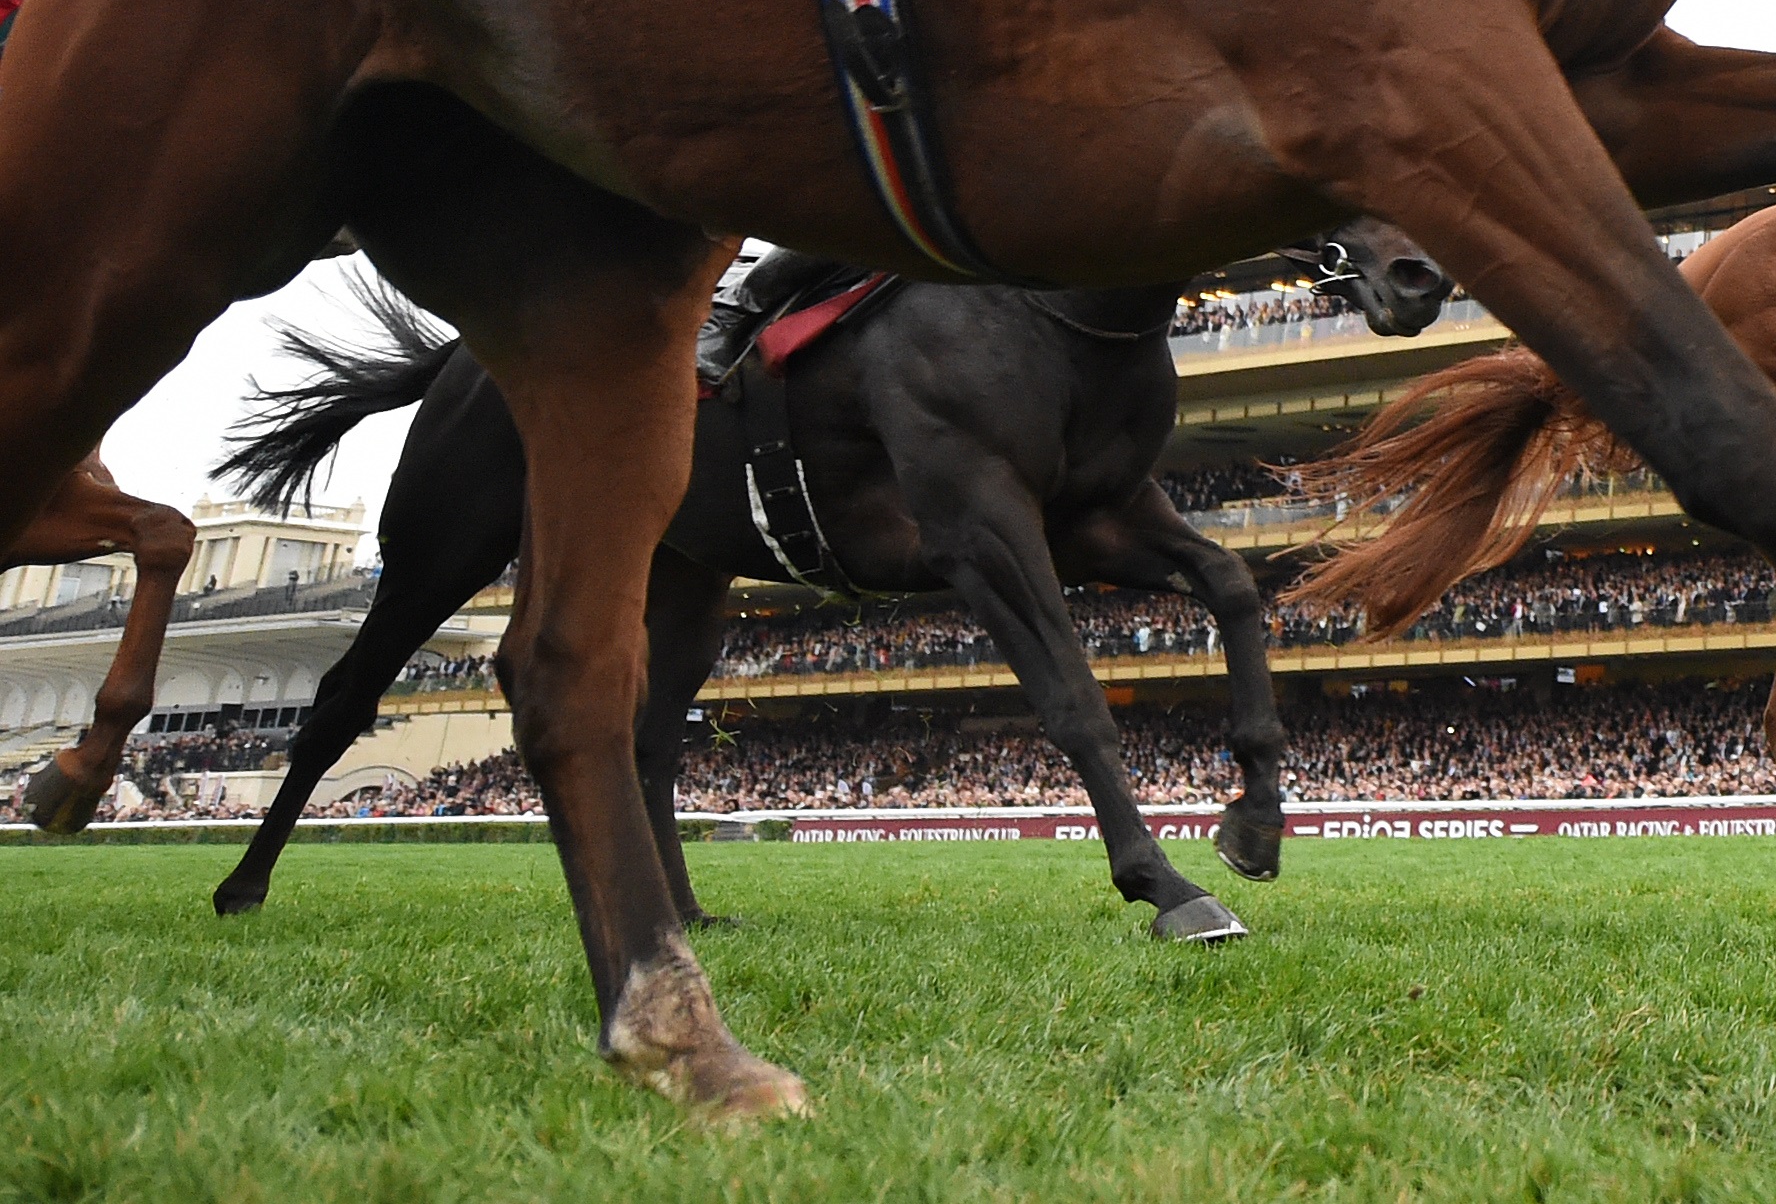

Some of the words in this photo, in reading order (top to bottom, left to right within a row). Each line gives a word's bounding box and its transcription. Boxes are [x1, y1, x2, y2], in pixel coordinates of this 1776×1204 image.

[1418, 819, 1505, 838] SERIES
[1558, 821, 1611, 837] QATAR
[1615, 820, 1680, 837] RACING
